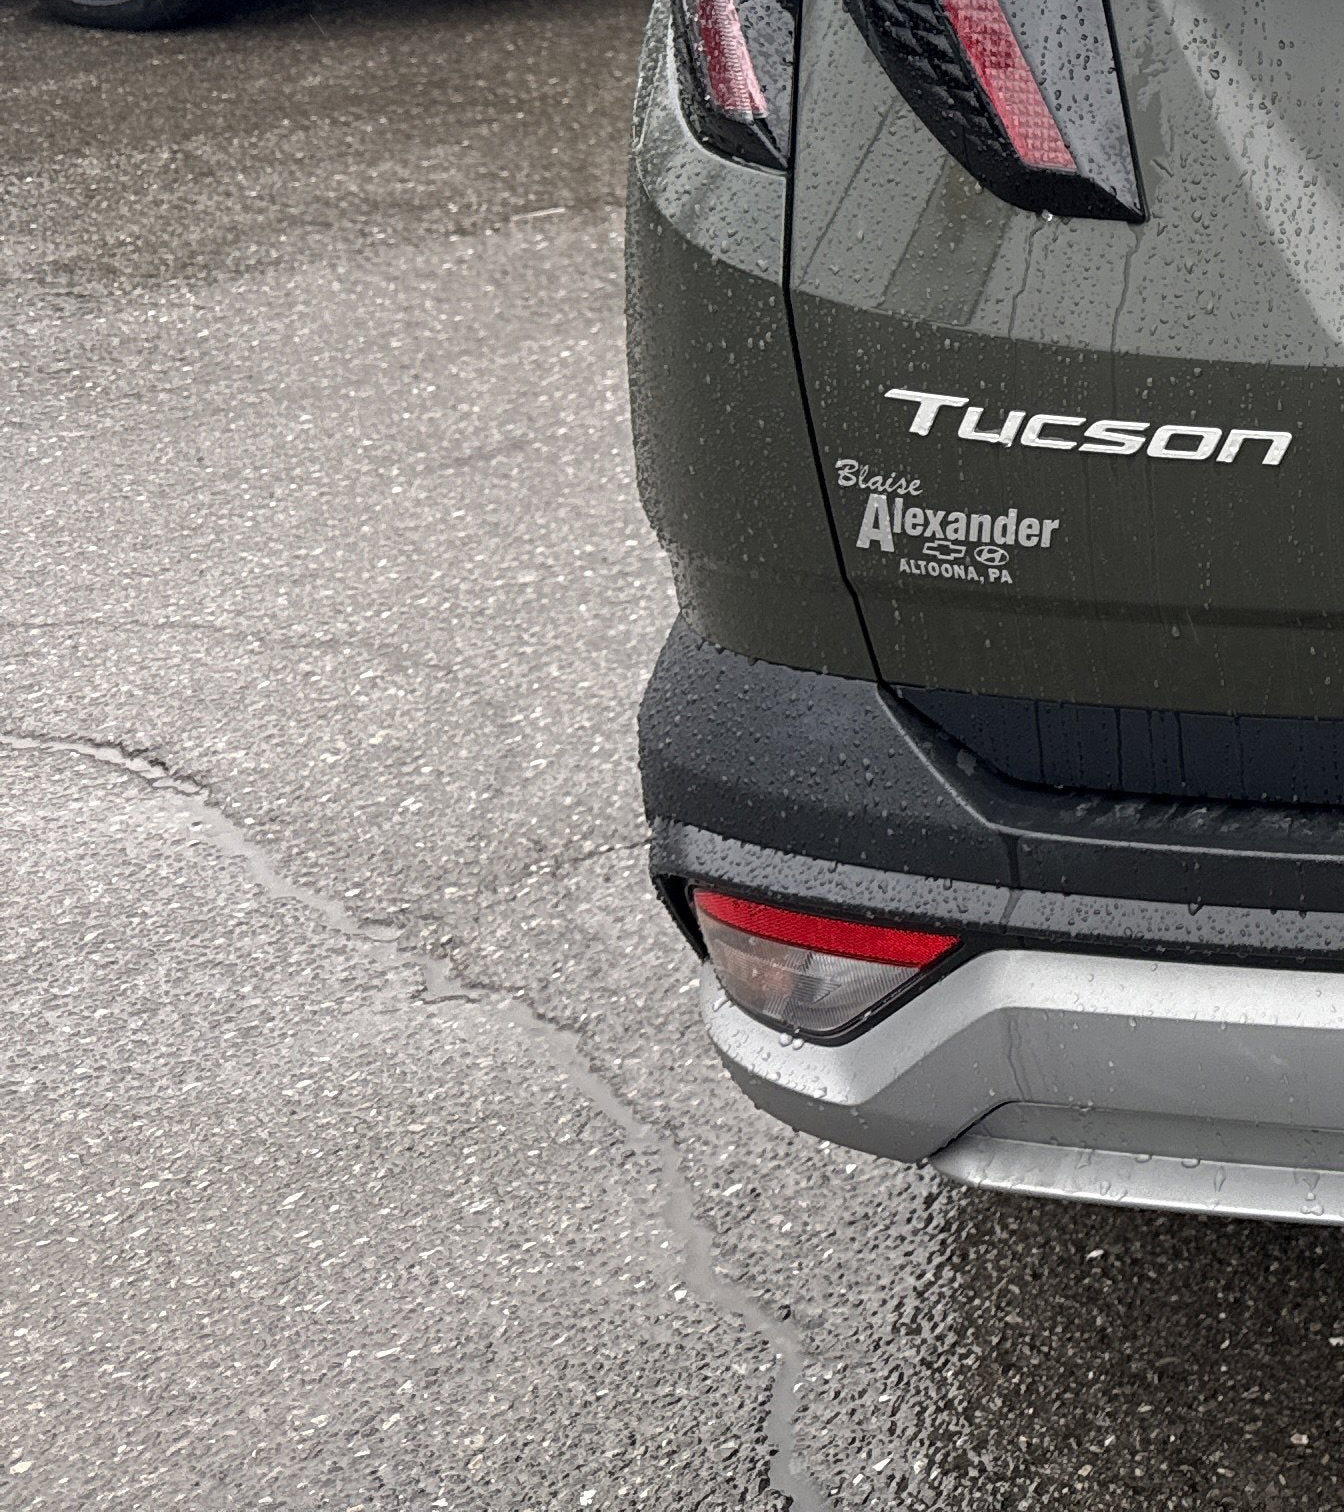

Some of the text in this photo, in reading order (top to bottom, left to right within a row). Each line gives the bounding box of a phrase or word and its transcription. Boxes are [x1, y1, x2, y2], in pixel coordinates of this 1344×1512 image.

[835, 458, 923, 497] Blaise
[855, 492, 1060, 553] Alexander
[899, 557, 1014, 585] ALTOONA, PA
